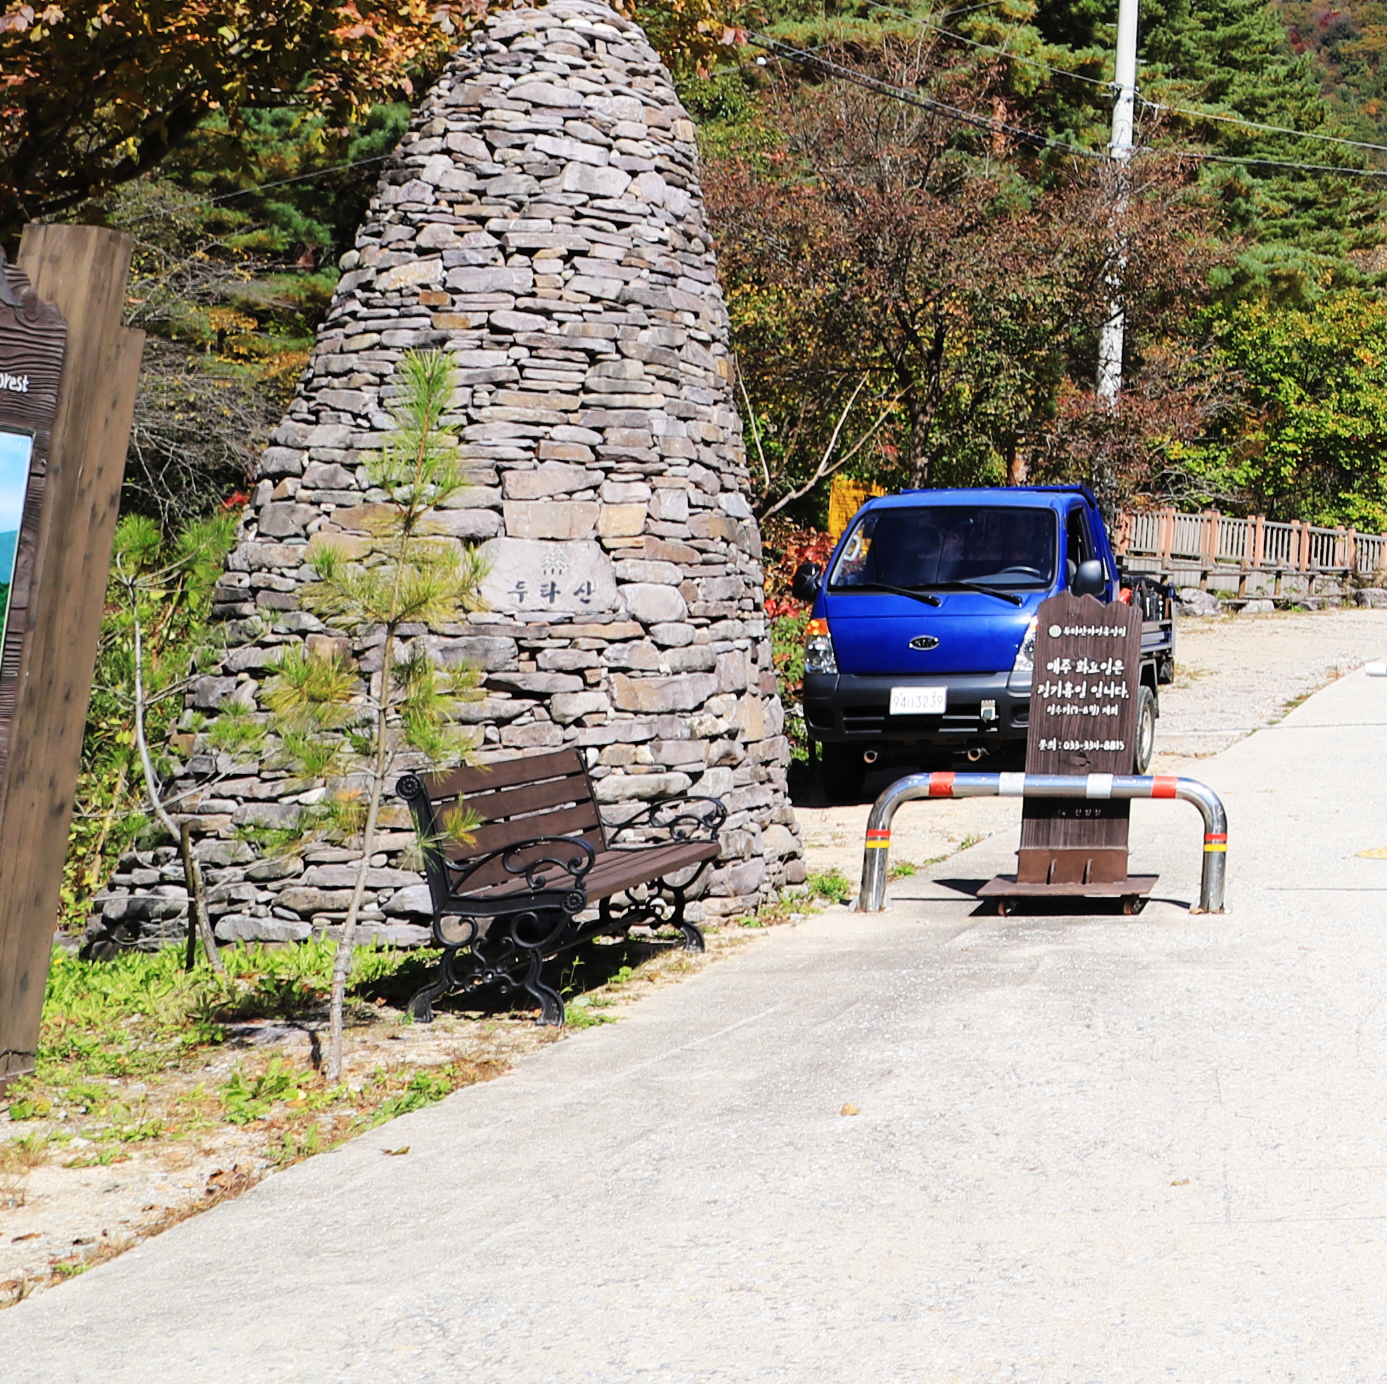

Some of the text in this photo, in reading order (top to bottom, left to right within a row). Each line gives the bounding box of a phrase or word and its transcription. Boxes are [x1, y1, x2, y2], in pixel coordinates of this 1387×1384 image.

[508, 580, 597, 604] 두타산
[1046, 657, 1125, 675] 매주 화요일은
[1037, 680, 1087, 698] 정기휴일
